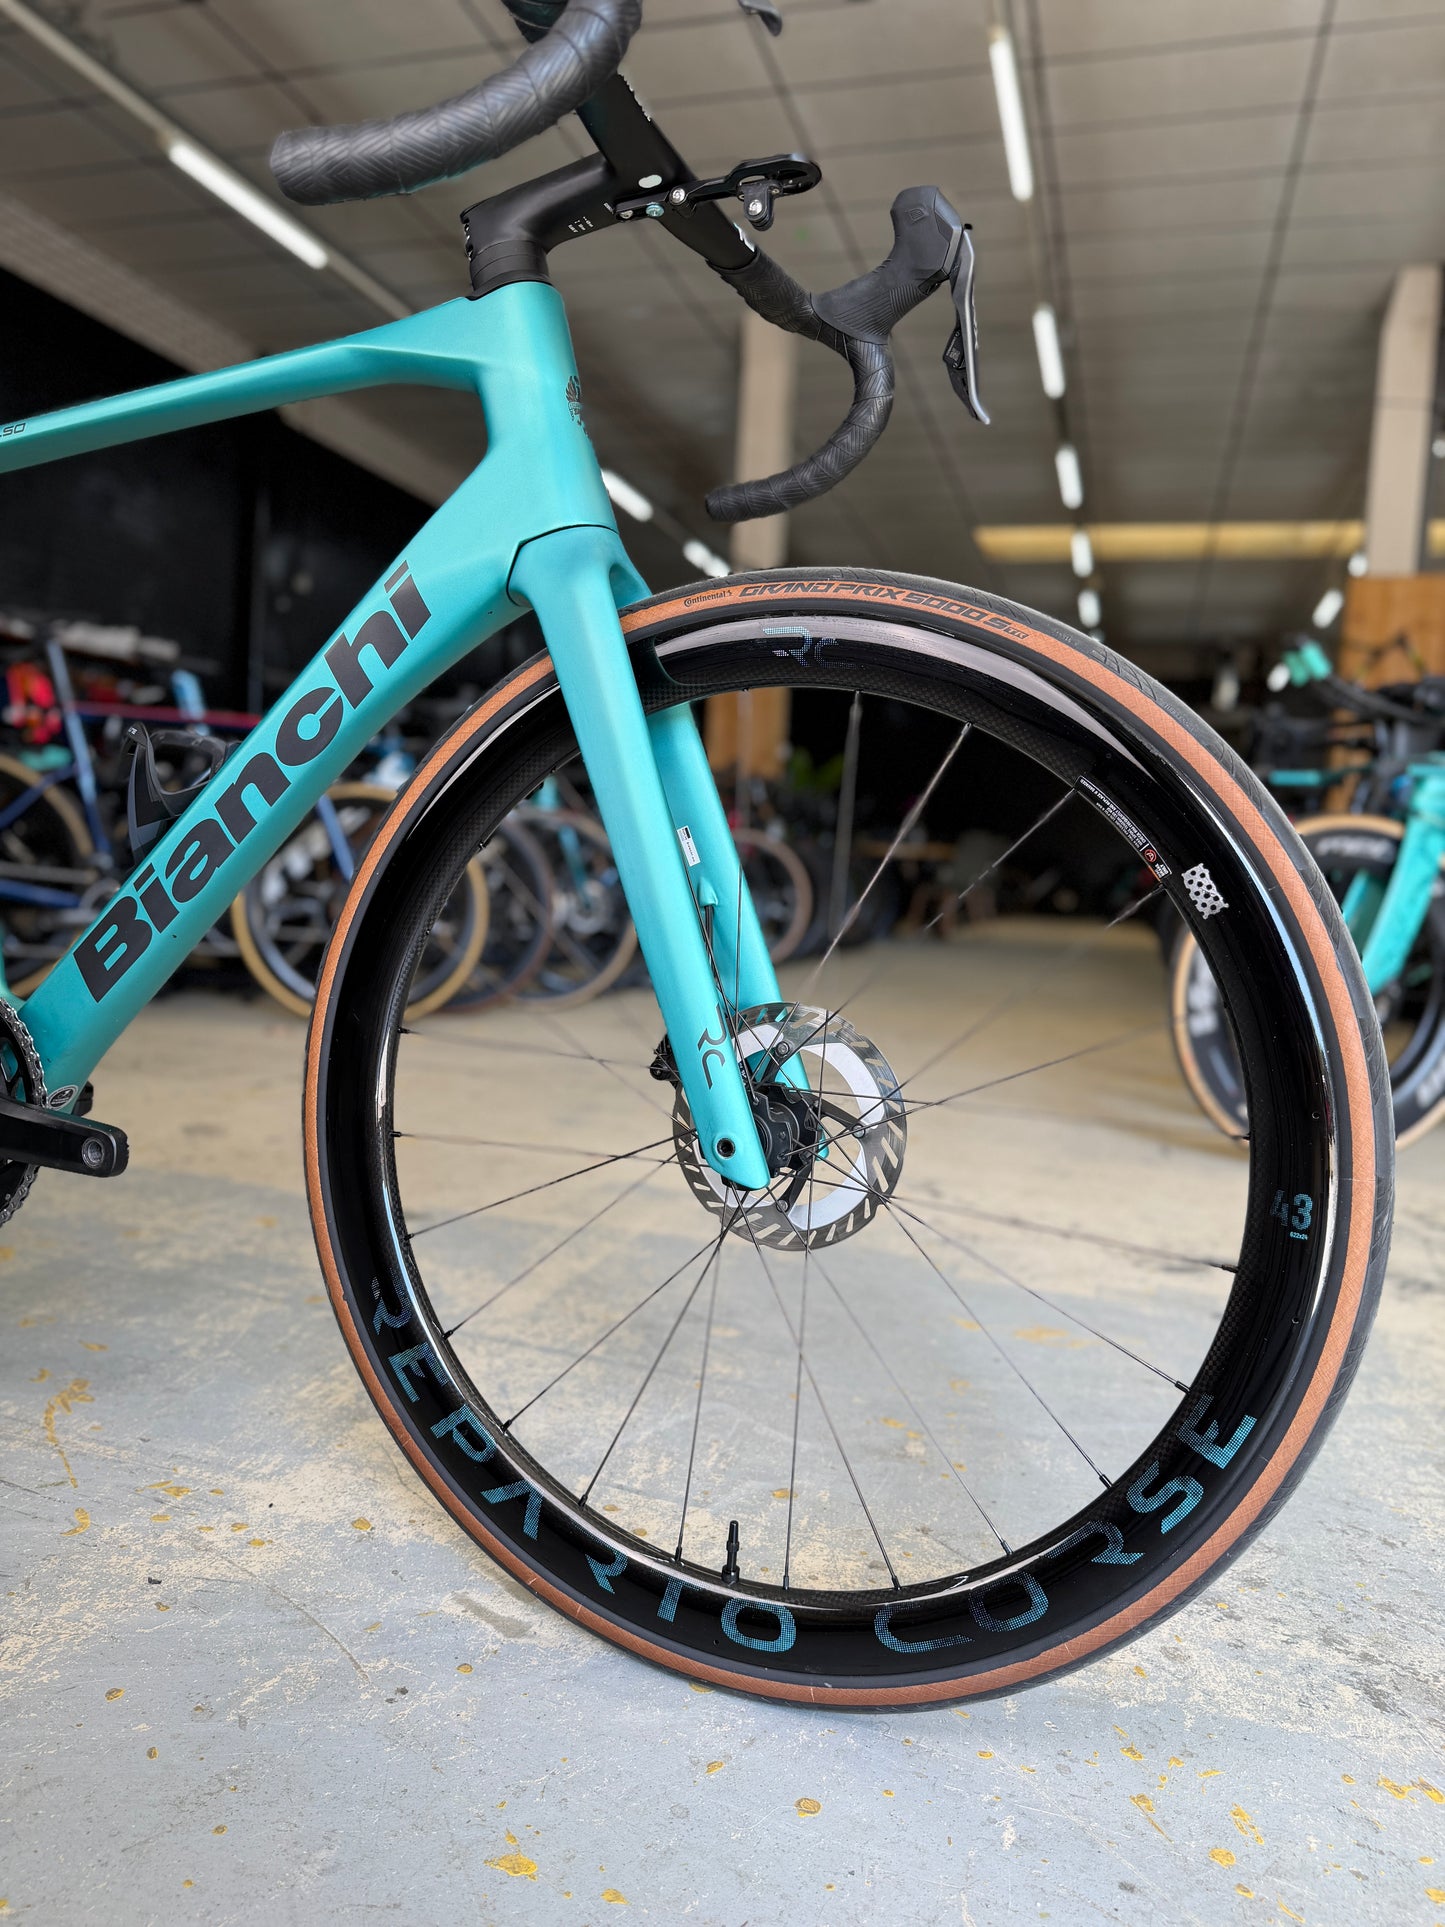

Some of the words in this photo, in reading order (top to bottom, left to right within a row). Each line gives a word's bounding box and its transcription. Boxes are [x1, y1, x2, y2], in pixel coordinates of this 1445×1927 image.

[0, 422, 26, 437] SO
[684, 590, 726, 607] Continental
[739, 582, 832, 598] GRAND
[833, 583, 905, 600] PRIX
[901, 592, 988, 622] 5000
[73, 560, 432, 1003] Bianchi
[1269, 1190, 1313, 1230] 43
[370, 1268, 797, 1653] REPARTO
[874, 1393, 1257, 1653] CORSE
